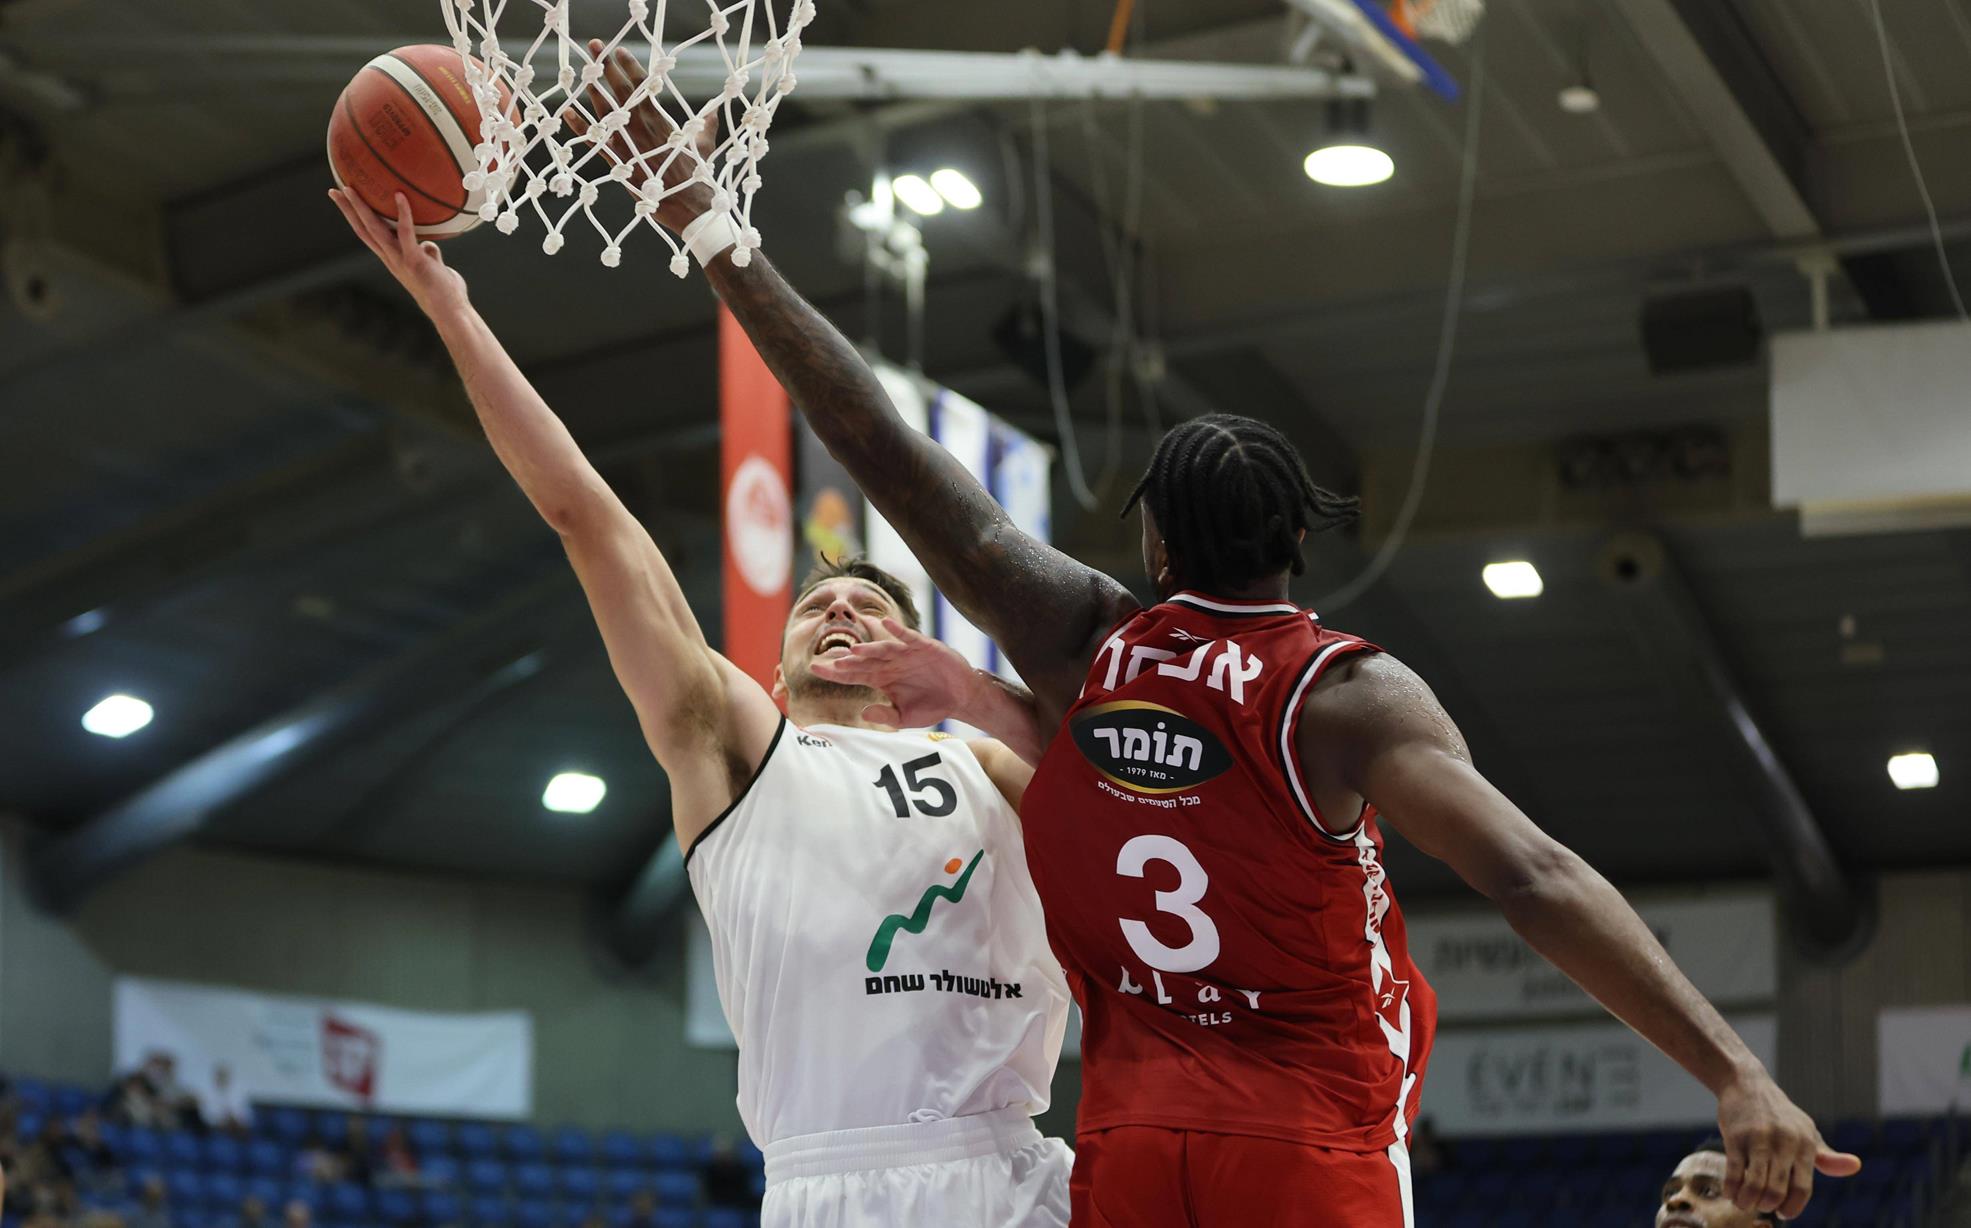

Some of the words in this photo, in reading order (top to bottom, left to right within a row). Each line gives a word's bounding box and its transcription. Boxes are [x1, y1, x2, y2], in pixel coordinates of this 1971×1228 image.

[1126, 766, 1147, 777] 1979
[1149, 770, 1167, 780] מאז
[871, 751, 958, 819] 15
[1097, 780, 1135, 803] שבעולם
[1179, 795, 1201, 806] מכל
[1116, 834, 1220, 974] 3
[865, 973, 925, 995] שחם
[929, 969, 1023, 1000] אלטשולר
